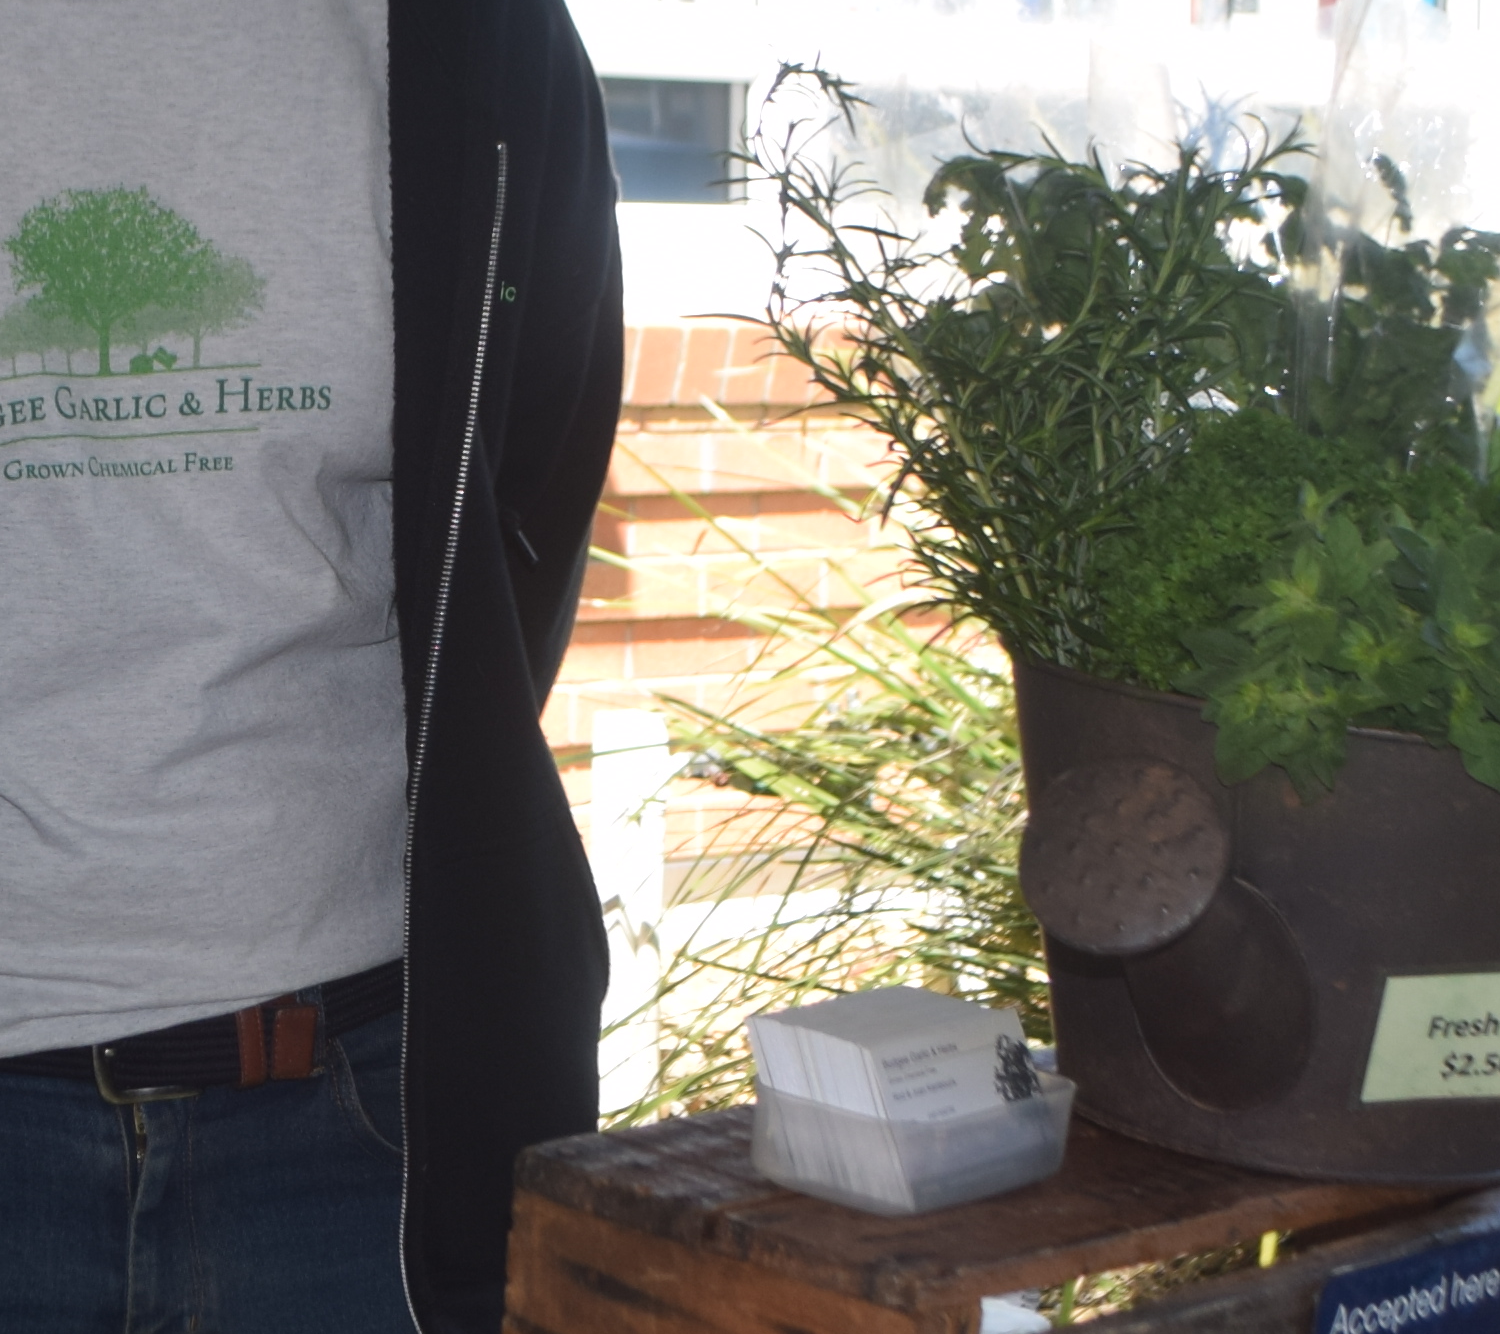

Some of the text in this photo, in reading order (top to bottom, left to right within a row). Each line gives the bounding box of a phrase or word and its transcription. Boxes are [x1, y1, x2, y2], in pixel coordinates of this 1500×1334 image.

[178, 392, 204, 417] &
[1427, 1012, 1500, 1039] Fresh
[1450, 1268, 1500, 1307] here
